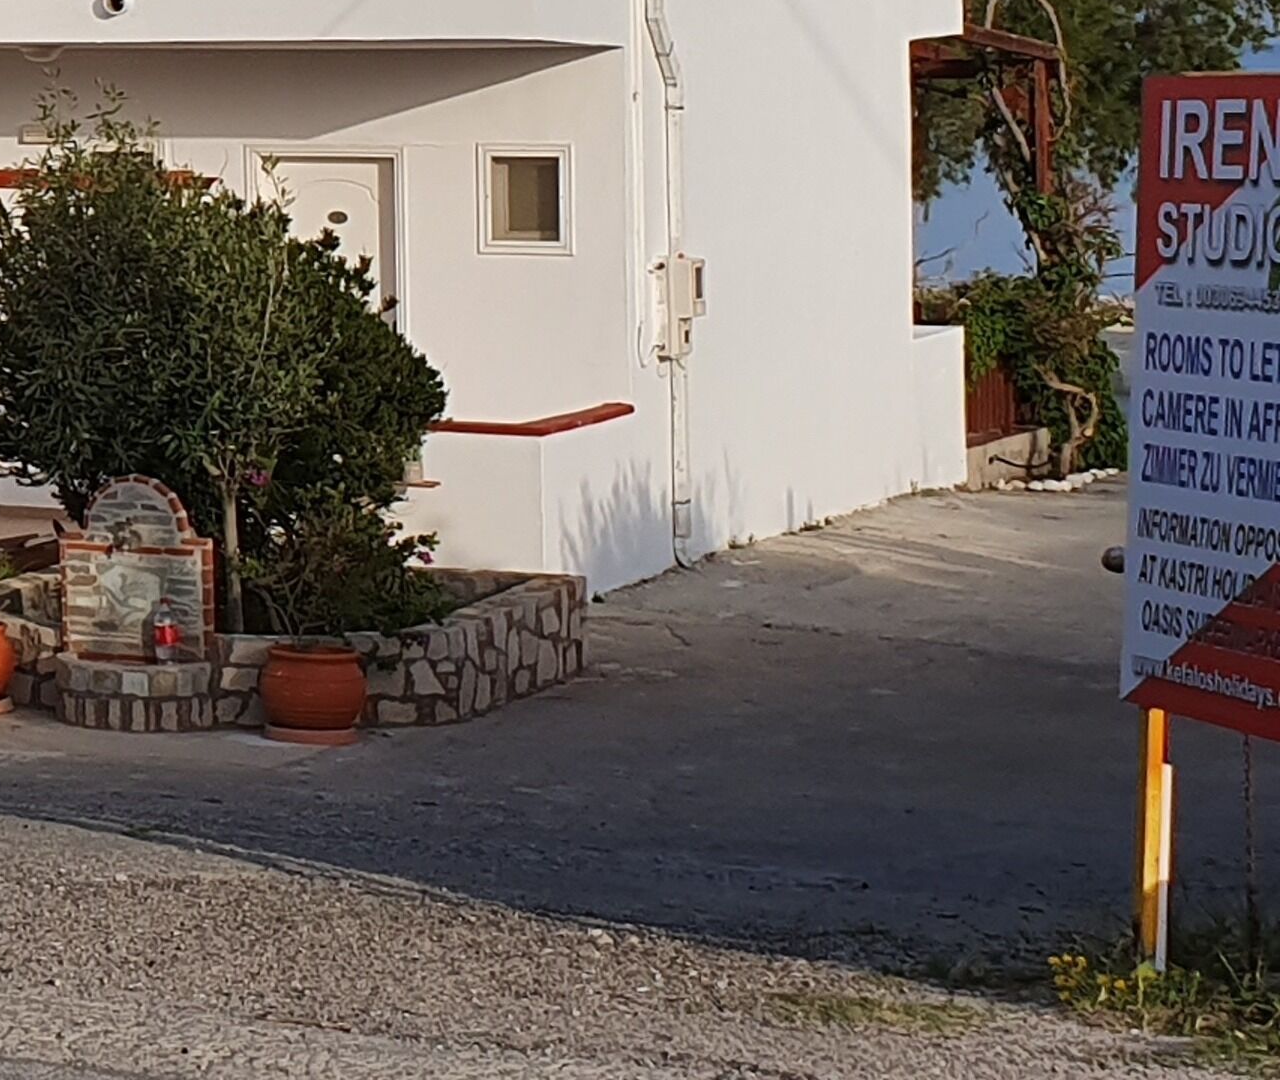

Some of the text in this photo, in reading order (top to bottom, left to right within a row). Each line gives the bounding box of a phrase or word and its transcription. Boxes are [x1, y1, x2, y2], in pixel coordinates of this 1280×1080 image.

[1145, 331, 1213, 377] ROOMS
[1218, 338, 1244, 381] TO
[1142, 388, 1220, 437] CAMERE
[1224, 397, 1244, 440] IN
[1141, 443, 1198, 489] ZIMMER
[1200, 451, 1221, 493] ZU
[1137, 507, 1233, 554] INFORMATION
[1138, 554, 1158, 585] AT
[1158, 558, 1210, 598] KASTRI
[1141, 599, 1183, 639] OASIS
[1131, 656, 1280, 710] www.kefalosholidays.
